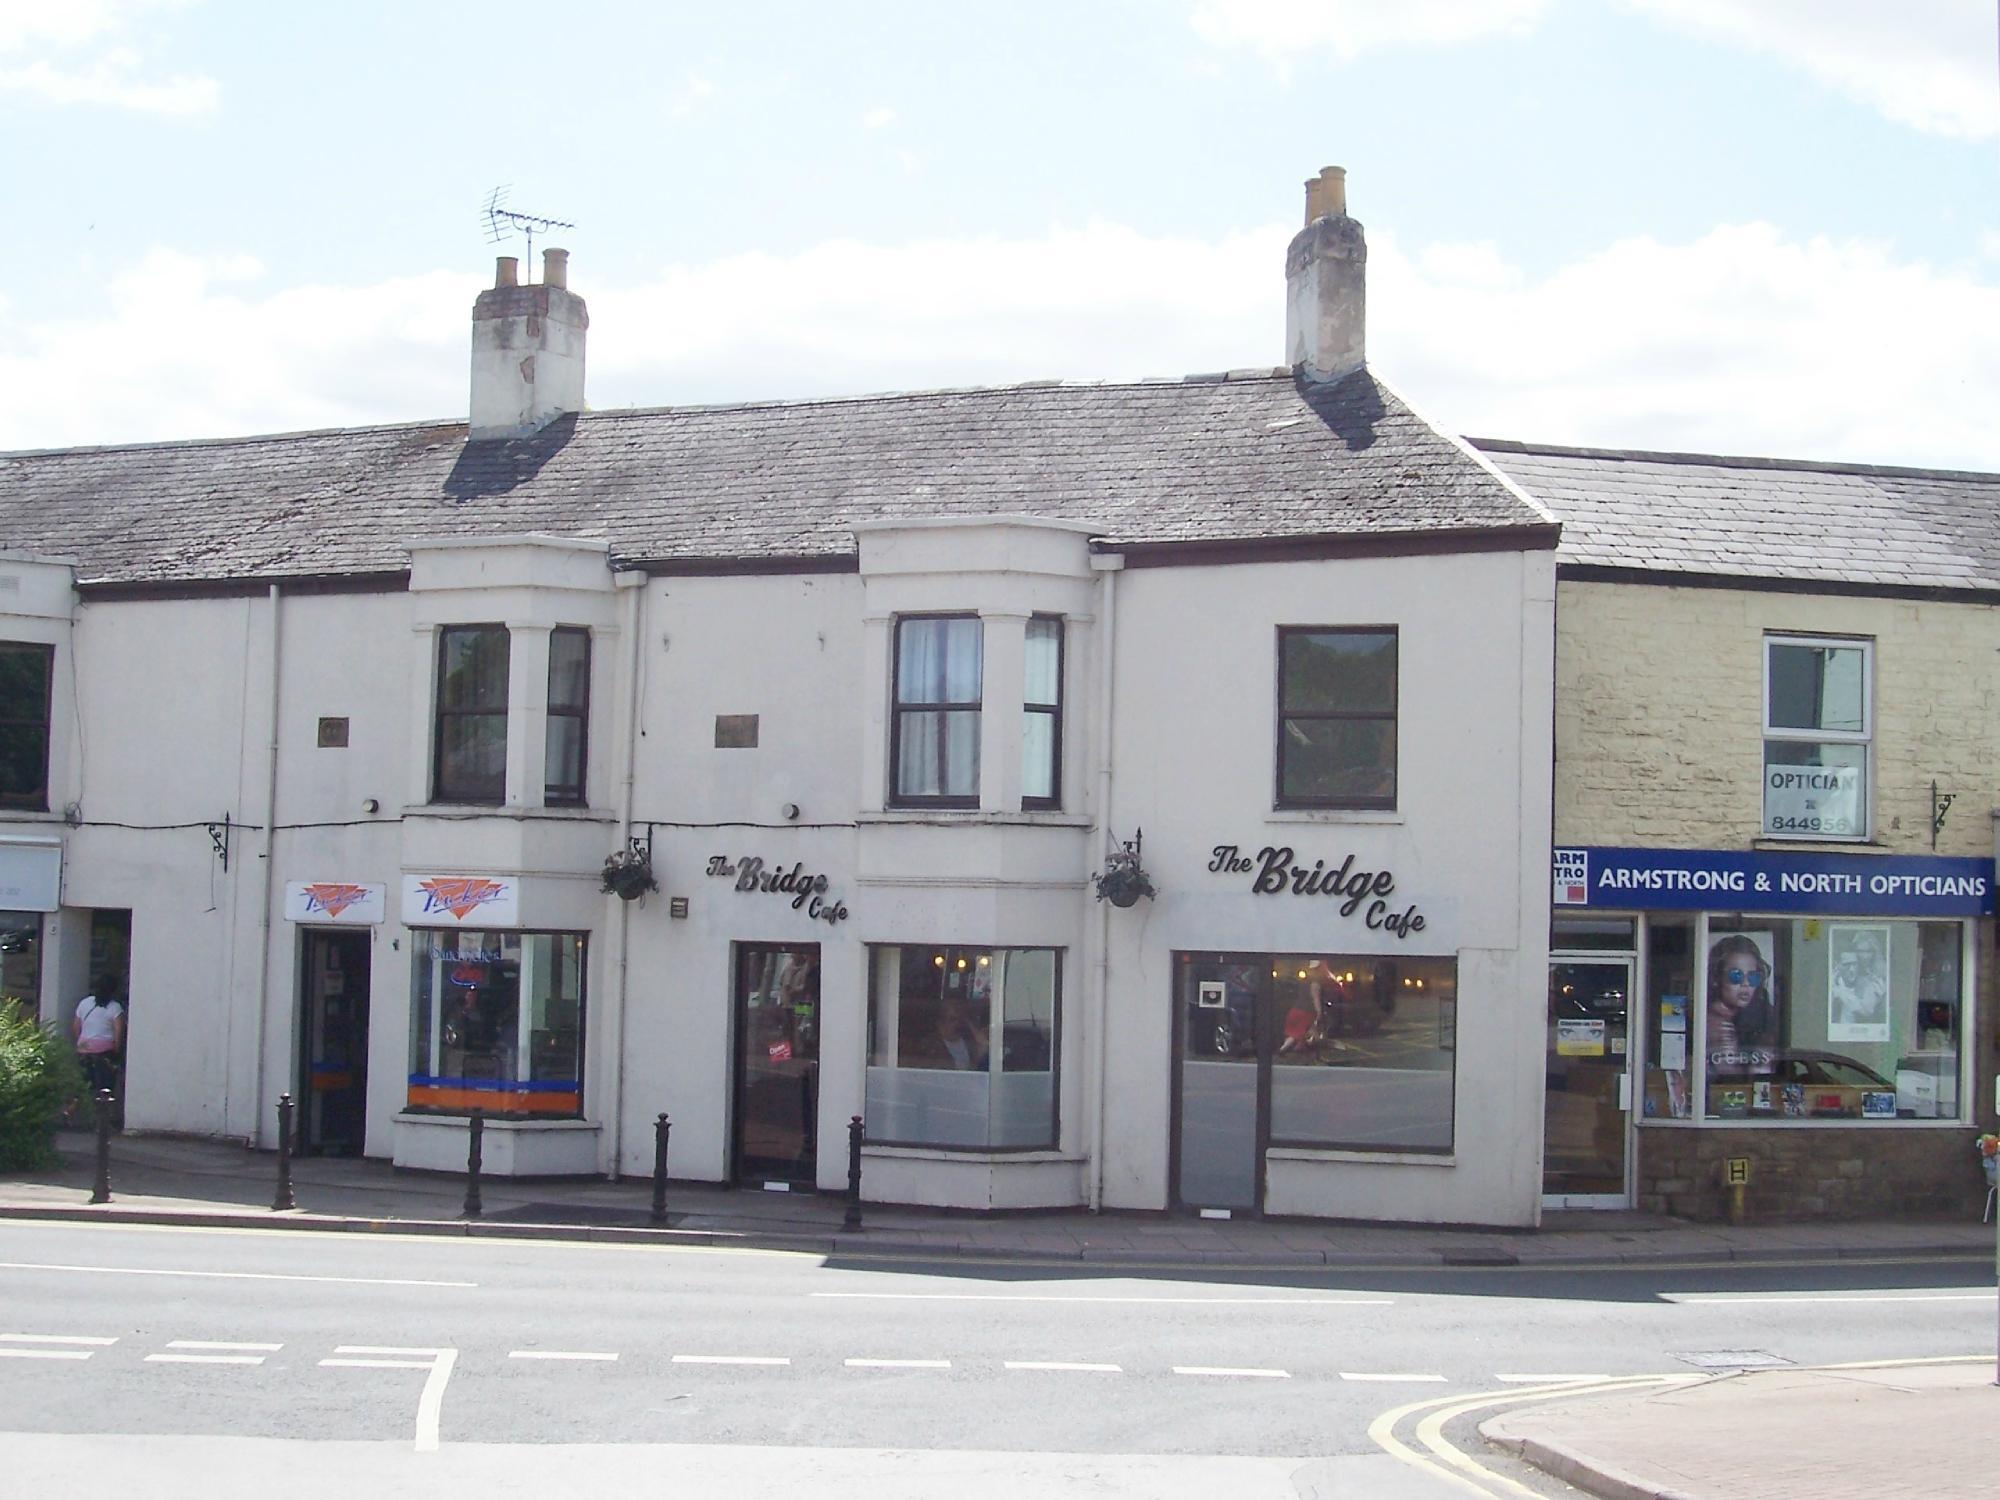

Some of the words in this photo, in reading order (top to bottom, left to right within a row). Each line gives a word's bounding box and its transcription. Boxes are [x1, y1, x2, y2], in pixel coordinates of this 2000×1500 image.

[1771, 773, 1855, 791] OPTICIAN
[1772, 816, 1850, 832] 844956
[706, 856, 735, 876] The
[734, 856, 829, 910] Bridge
[1208, 845, 1253, 873] The
[1252, 847, 1395, 918] Bridge
[1599, 868, 1745, 892] ARMSTRONG
[1754, 872, 1772, 892] &
[1781, 873, 1861, 894] NORTH
[1870, 875, 1986, 897] OPTICIANS
[808, 896, 849, 926] Cafe
[1366, 900, 1426, 940] Cafe
[1711, 1050, 1771, 1065] GUESS
[1730, 1160, 1746, 1182] H
